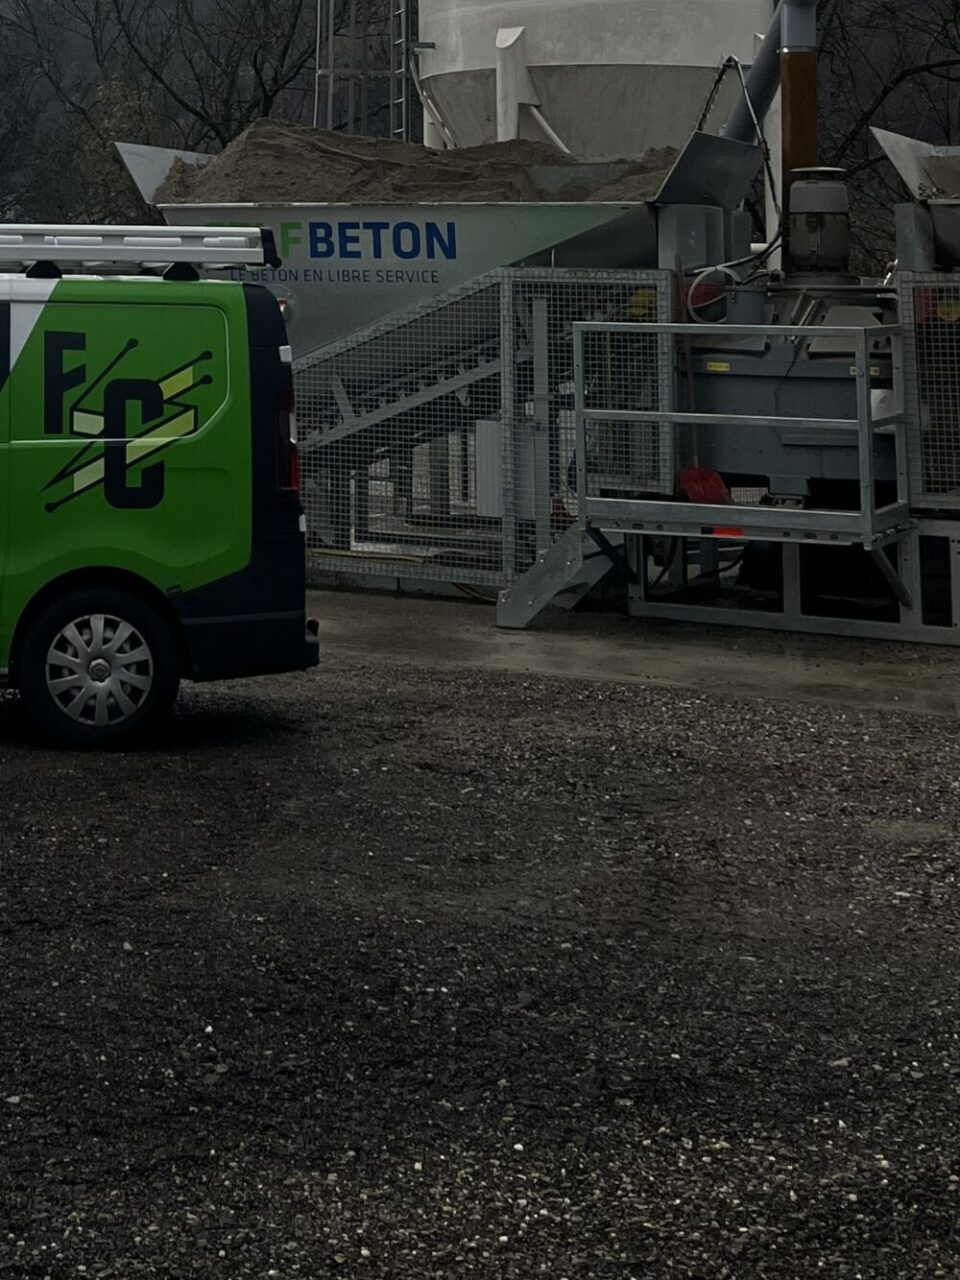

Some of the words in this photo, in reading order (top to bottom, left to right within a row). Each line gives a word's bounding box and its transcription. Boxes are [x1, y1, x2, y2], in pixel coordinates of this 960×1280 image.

[207, 221, 457, 260] FBETON
[304, 270, 323, 282] EN
[328, 270, 370, 283] LIBRE
[376, 270, 439, 283] SERVICE
